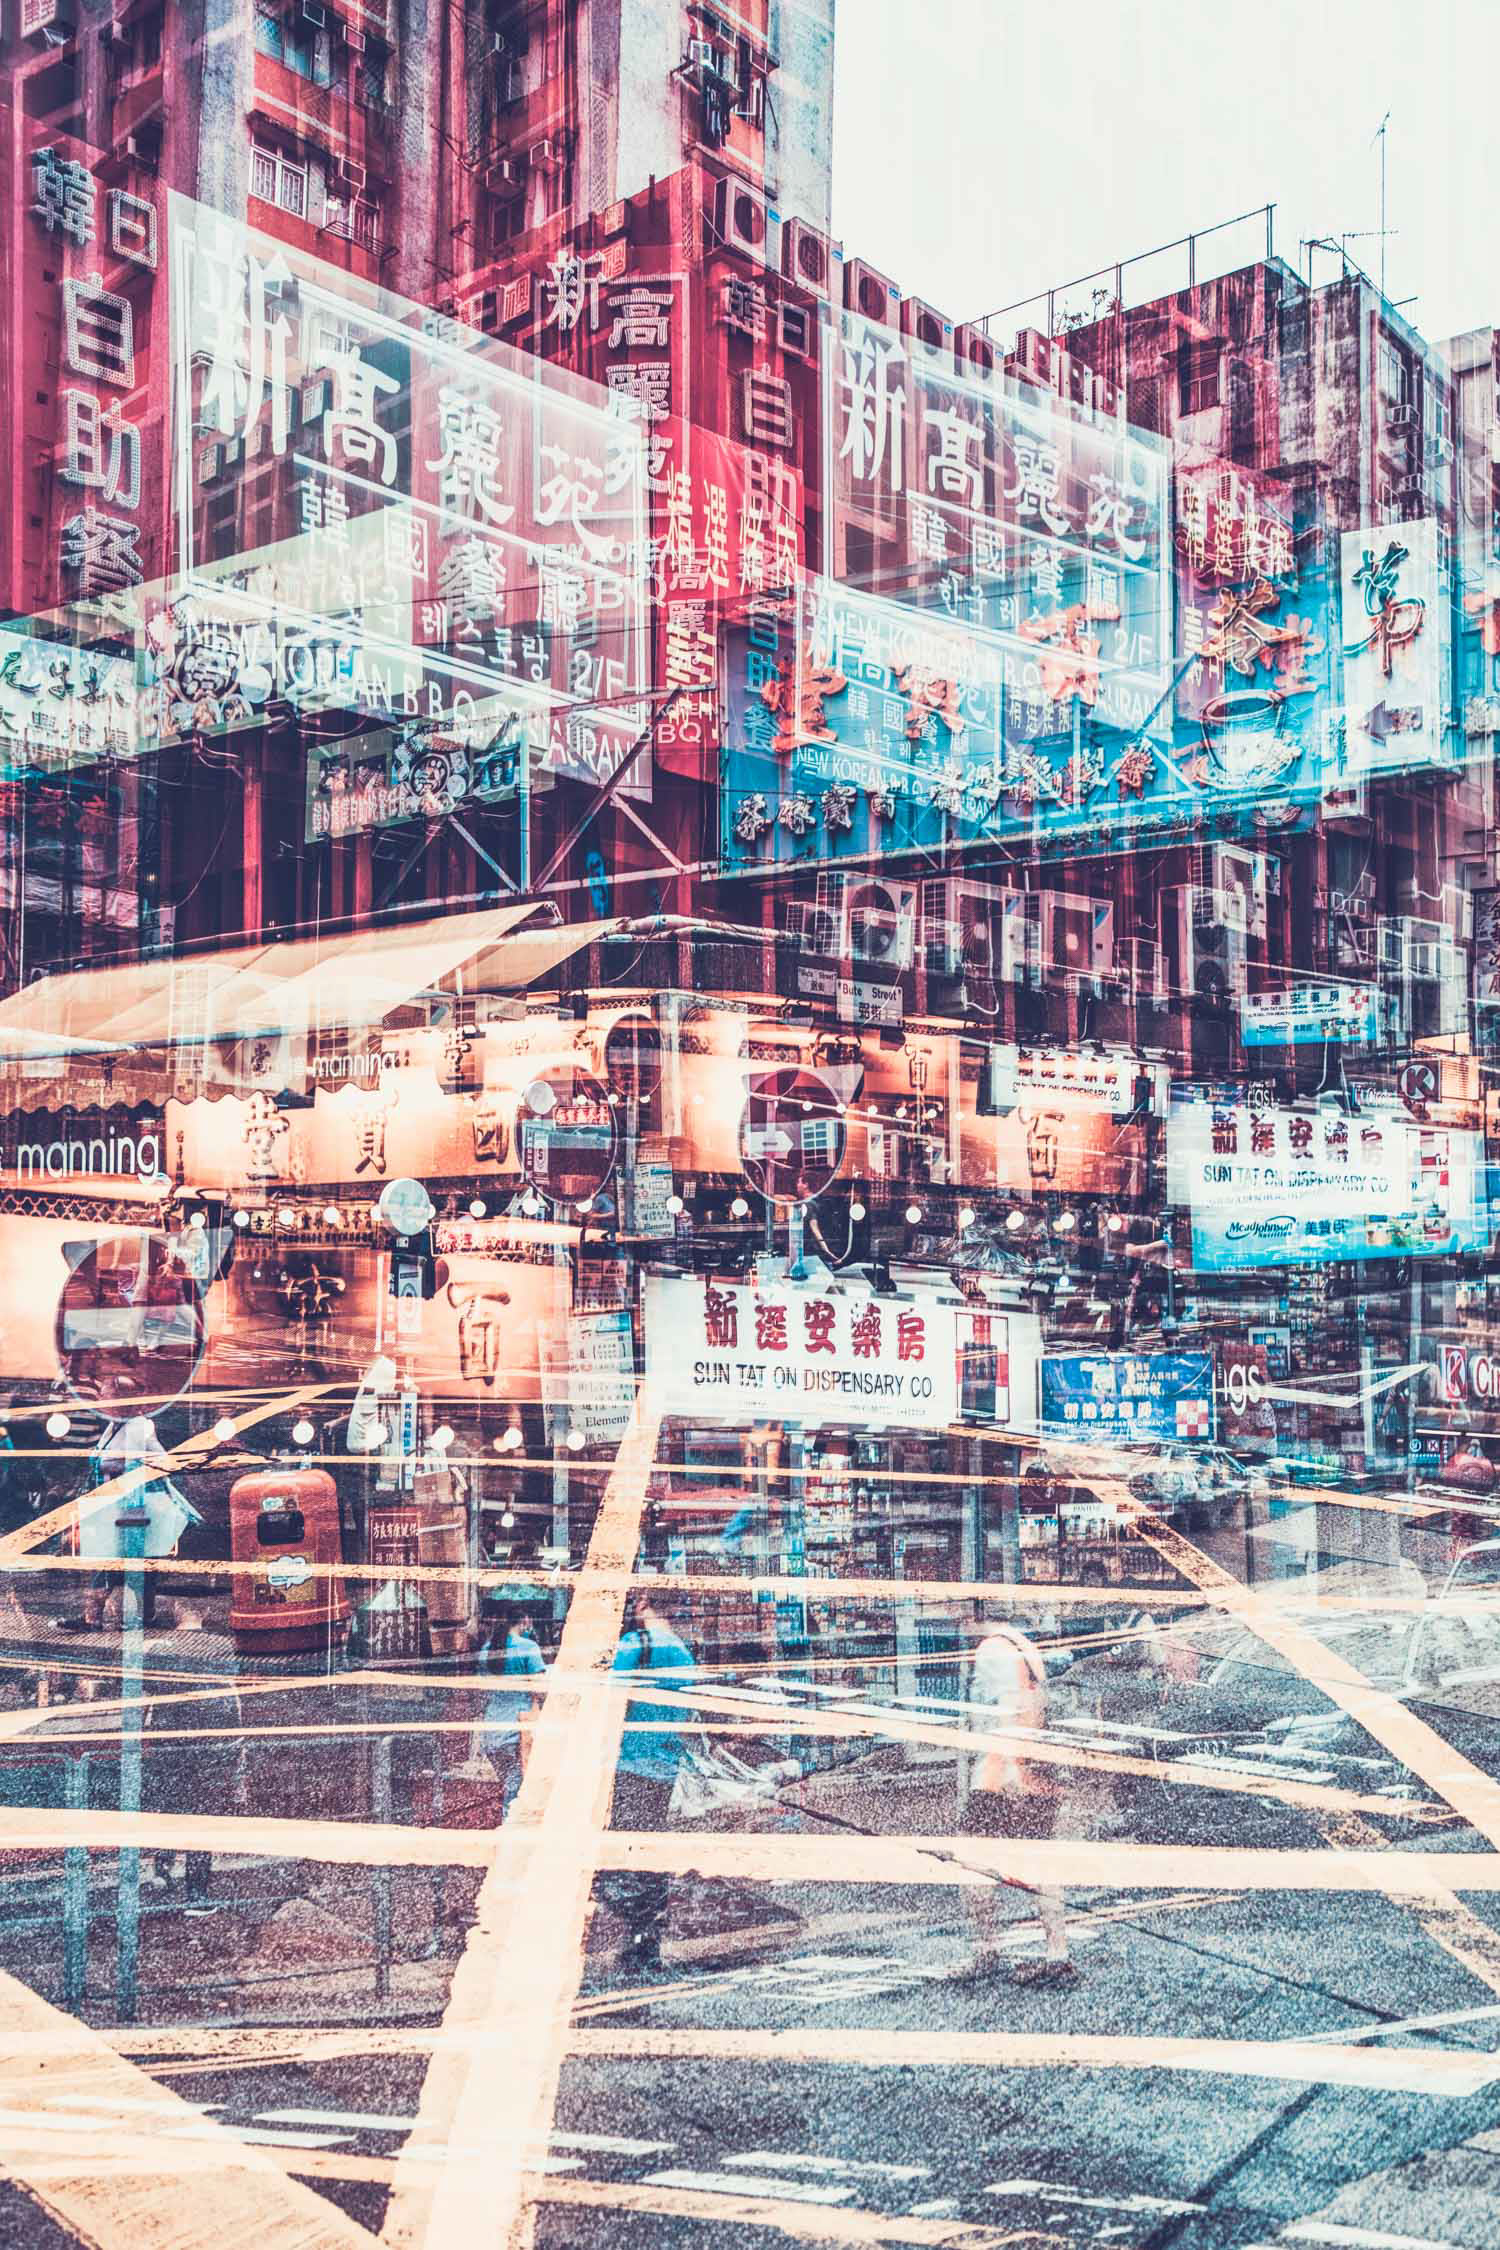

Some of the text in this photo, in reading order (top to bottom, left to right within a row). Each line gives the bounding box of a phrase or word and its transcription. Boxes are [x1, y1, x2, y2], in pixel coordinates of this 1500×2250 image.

[842, 983, 898, 1001] Bute Street
[1203, 1164, 1232, 1183] SUN
[693, 1361, 730, 1385] SUN
[736, 1363, 767, 1388] TAT
[773, 1366, 797, 1390] ON
[803, 1368, 904, 1398] DISPENSARY
